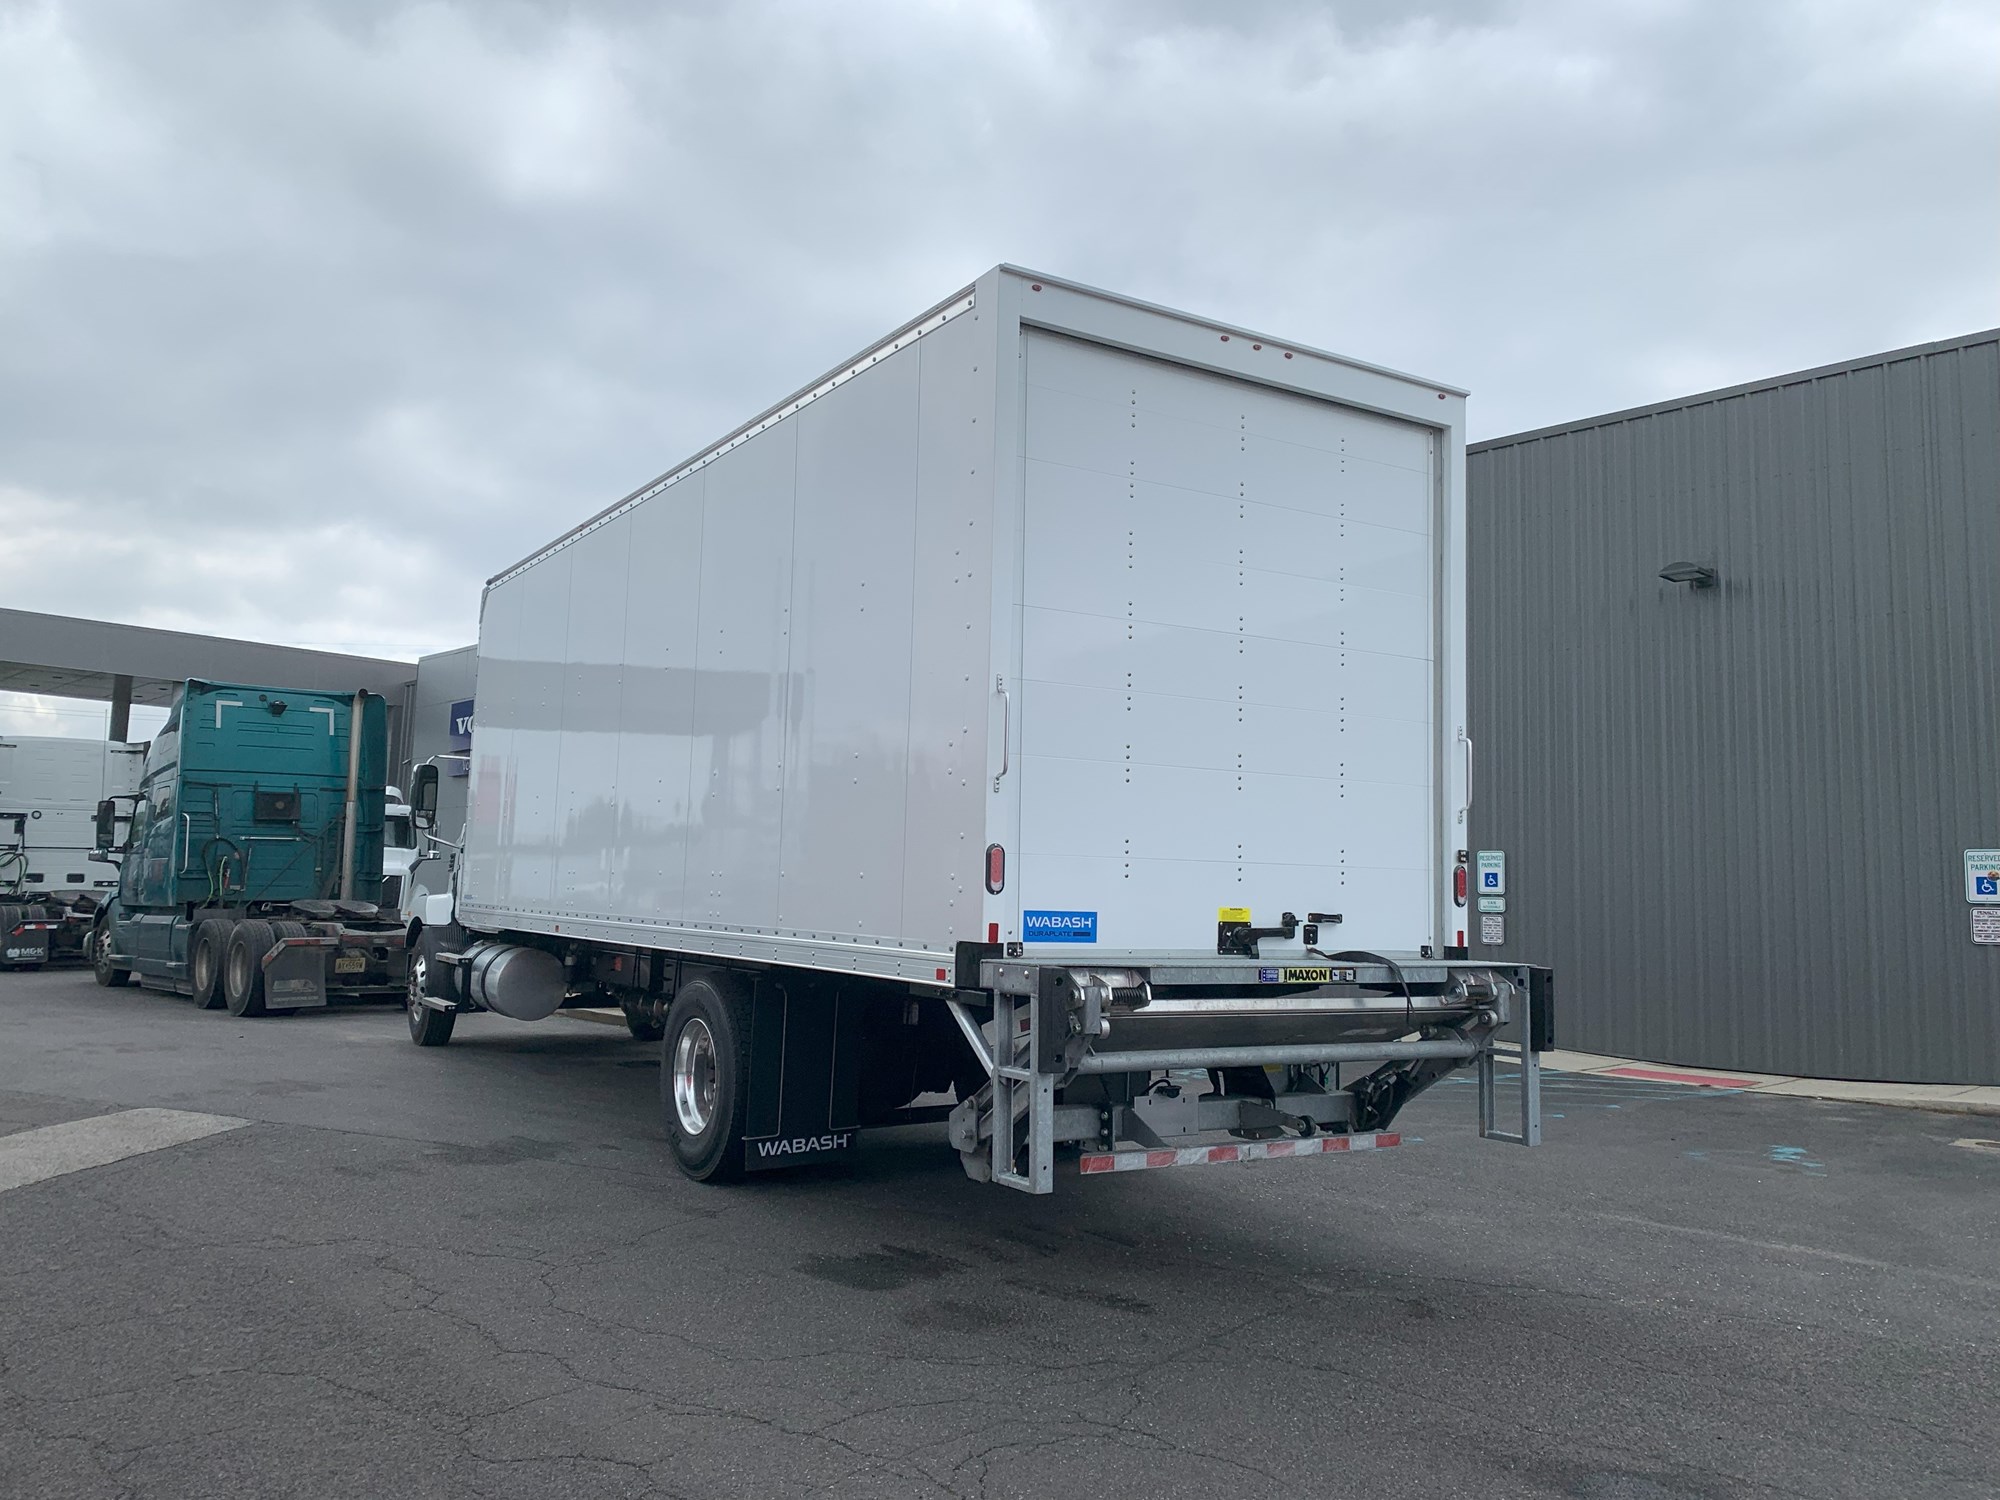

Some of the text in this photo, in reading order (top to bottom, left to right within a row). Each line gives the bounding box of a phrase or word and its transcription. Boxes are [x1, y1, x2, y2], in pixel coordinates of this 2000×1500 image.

[1026, 916, 1092, 929] WABASH
[1288, 969, 1327, 981] MAXON
[757, 1134, 847, 1157] WABASH
